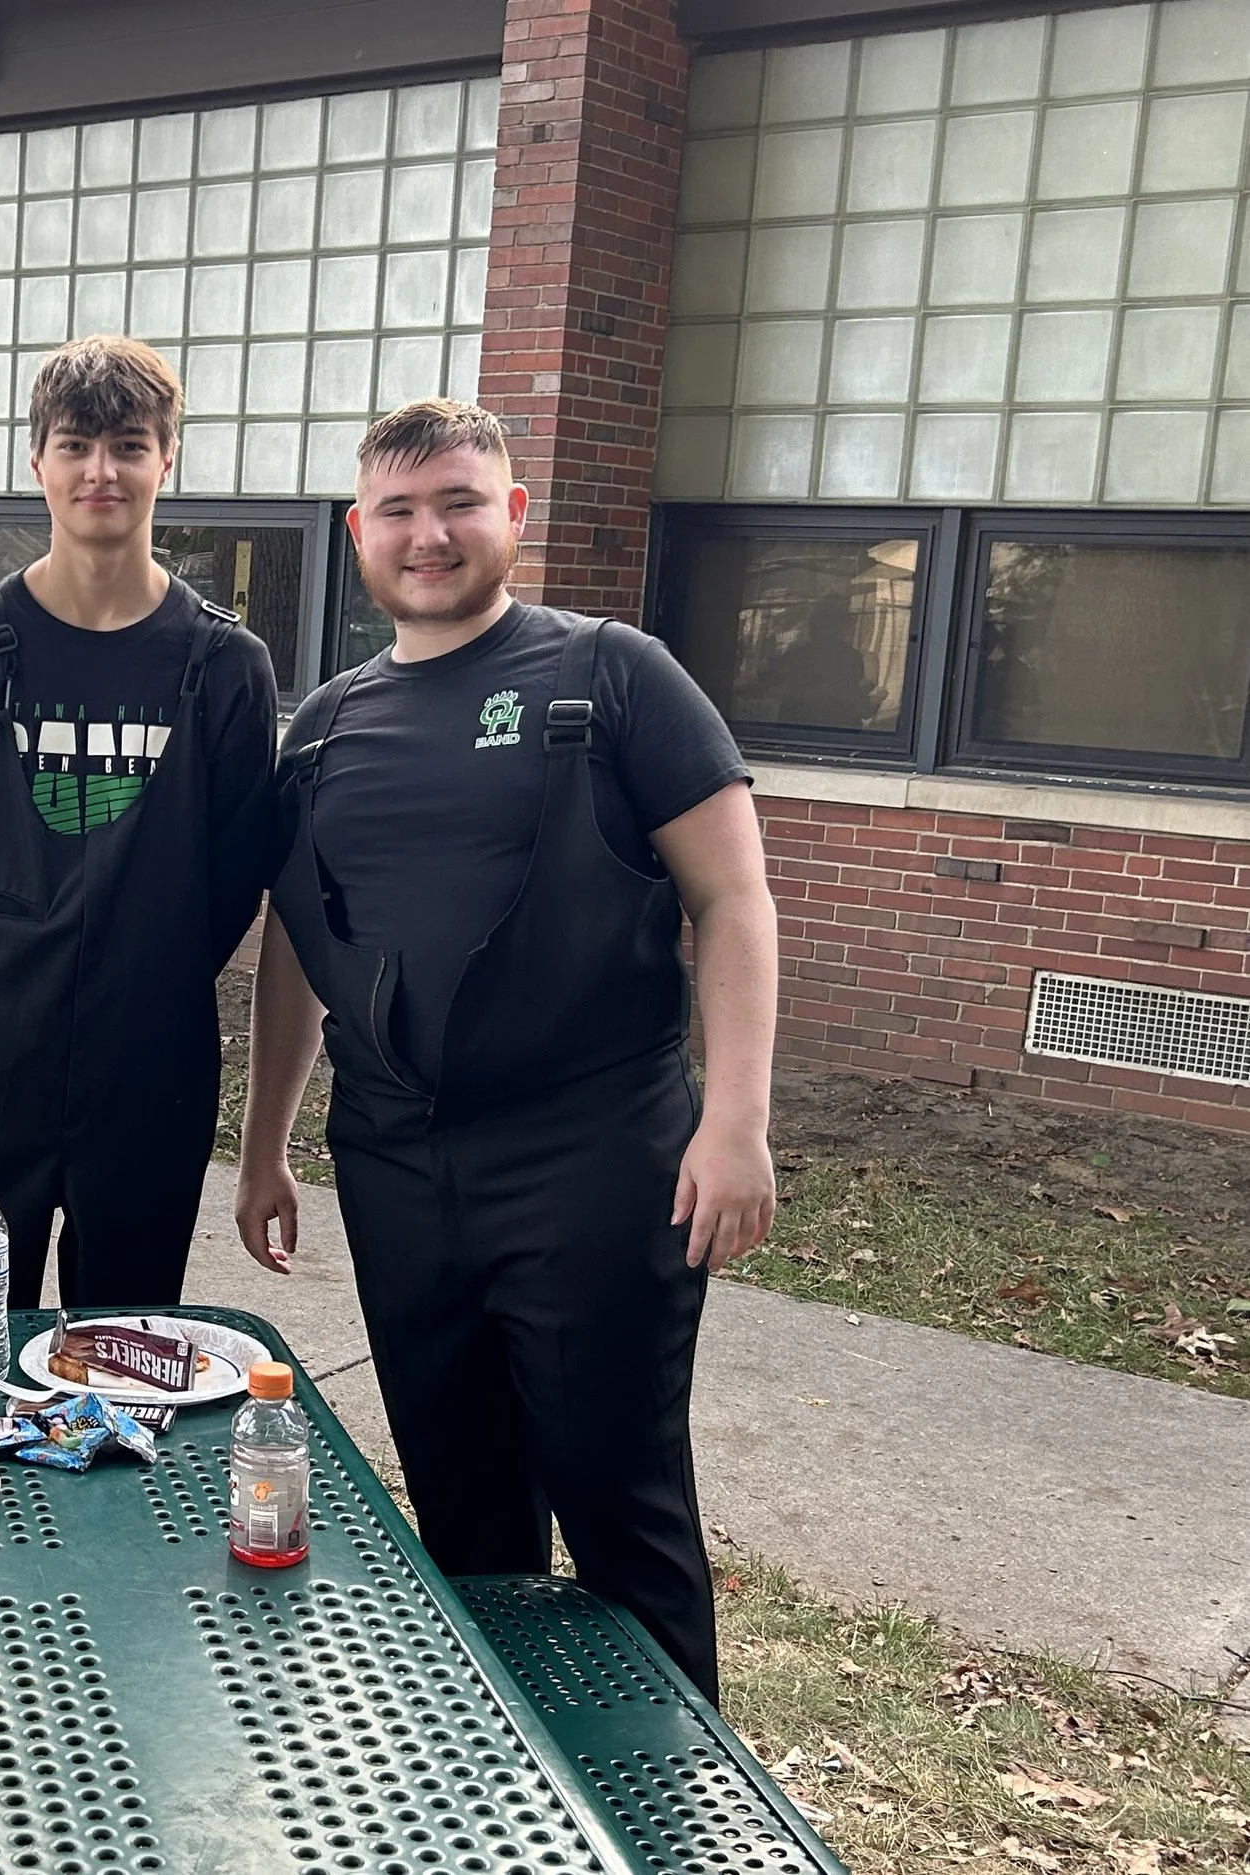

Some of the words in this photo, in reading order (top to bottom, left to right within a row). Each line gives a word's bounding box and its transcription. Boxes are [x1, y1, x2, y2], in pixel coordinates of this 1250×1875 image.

[118, 705, 164, 723] HIL
[475, 733, 520, 749] BAND
[105, 758, 157, 775] BEA
[94, 1341, 184, 1387] HERSHEY'S
